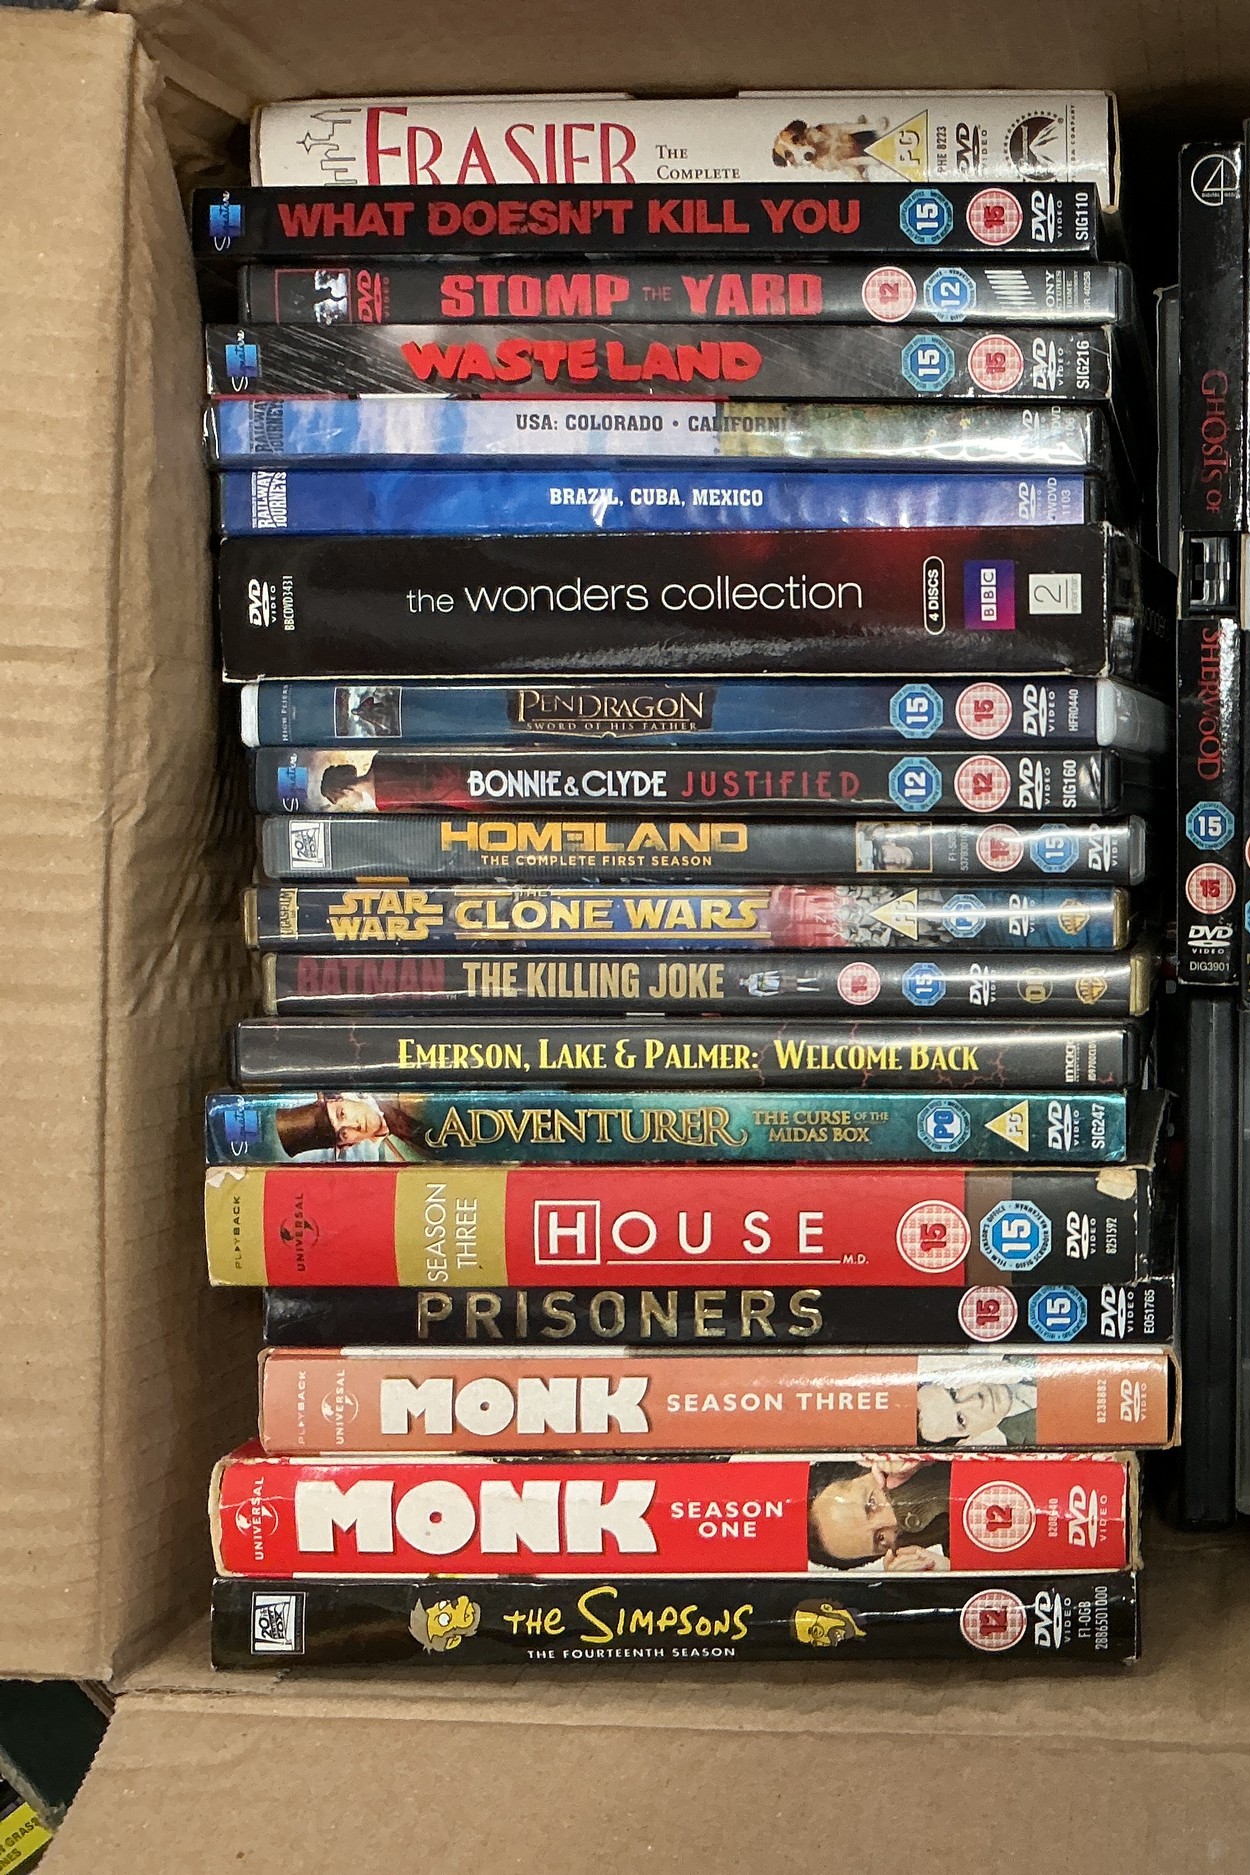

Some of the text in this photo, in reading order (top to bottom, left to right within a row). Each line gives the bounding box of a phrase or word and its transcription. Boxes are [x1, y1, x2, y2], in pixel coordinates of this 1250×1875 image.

[366, 107, 637, 186] FRASIER
[656, 145, 688, 160] THE
[656, 166, 741, 180] COMPLETE
[277, 198, 861, 237] WHAT DOESN'T KILL YOU
[916, 203, 940, 229] 15
[1031, 190, 1045, 242] DVD
[1075, 192, 1089, 241] SIG110
[441, 274, 823, 316] STOMP THE YARD
[401, 339, 763, 382] WASTE LAND
[1075, 340, 1090, 390] SIG216
[516, 414, 664, 432] USA: COLORADO
[257, 470, 271, 528] RAILWAY
[270, 471, 287, 528] JOURNEYS
[630, 488, 686, 508] CUBA,
[692, 490, 763, 507] MEXICO
[407, 575, 863, 613] the wonders collection
[981, 569, 996, 620] BBC
[1197, 369, 1228, 781] GHOSTS OF SHERWOOD
[284, 575, 295, 631] BBCDVD3431
[517, 689, 704, 722] PENDRAGON
[526, 721, 583, 731] SWORD
[611, 722, 634, 731] HIS
[642, 721, 698, 732] FATHER
[468, 770, 563, 797] BONNIE
[582, 770, 667, 797] CLYDE
[681, 770, 860, 798] JUSTIFIED
[1063, 759, 1078, 808] SIG160
[441, 822, 748, 852] HOMELAND
[481, 856, 712, 867] THE COMPLETE FIRST SEASON
[329, 890, 443, 914] STAR
[455, 899, 770, 930] CLONE WARS
[329, 917, 443, 941] WARS
[297, 959, 724, 999] BATMAN THE KILLING JOKE
[1189, 960, 1230, 973] DIG3901
[398, 1039, 979, 1071] EMERSON, LAKE & PALMER: WELCOME BACK
[425, 1106, 748, 1148] ADVENTURER
[753, 1110, 889, 1126] THE CURSE OF THE
[769, 1128, 870, 1143] MIDAS BOX
[1092, 1103, 1105, 1149] SIG247
[427, 1183, 448, 1282] SEASON
[456, 1198, 478, 1269] THREE
[546, 1209, 870, 1265] HOUSE M.D.
[1105, 1217, 1118, 1254] 8251592
[417, 1289, 823, 1339] PRISONERS
[380, 1377, 890, 1436] MONK SEASON THREE
[254, 1476, 264, 1561] UNIVERSAL
[295, 1480, 657, 1555] MONK
[670, 1501, 784, 1519] SEASON
[698, 1521, 757, 1538] ONE
[577, 1586, 754, 1643] SIMPSONS
[527, 1647, 736, 1660] THE FOURTEENTH SEASON
